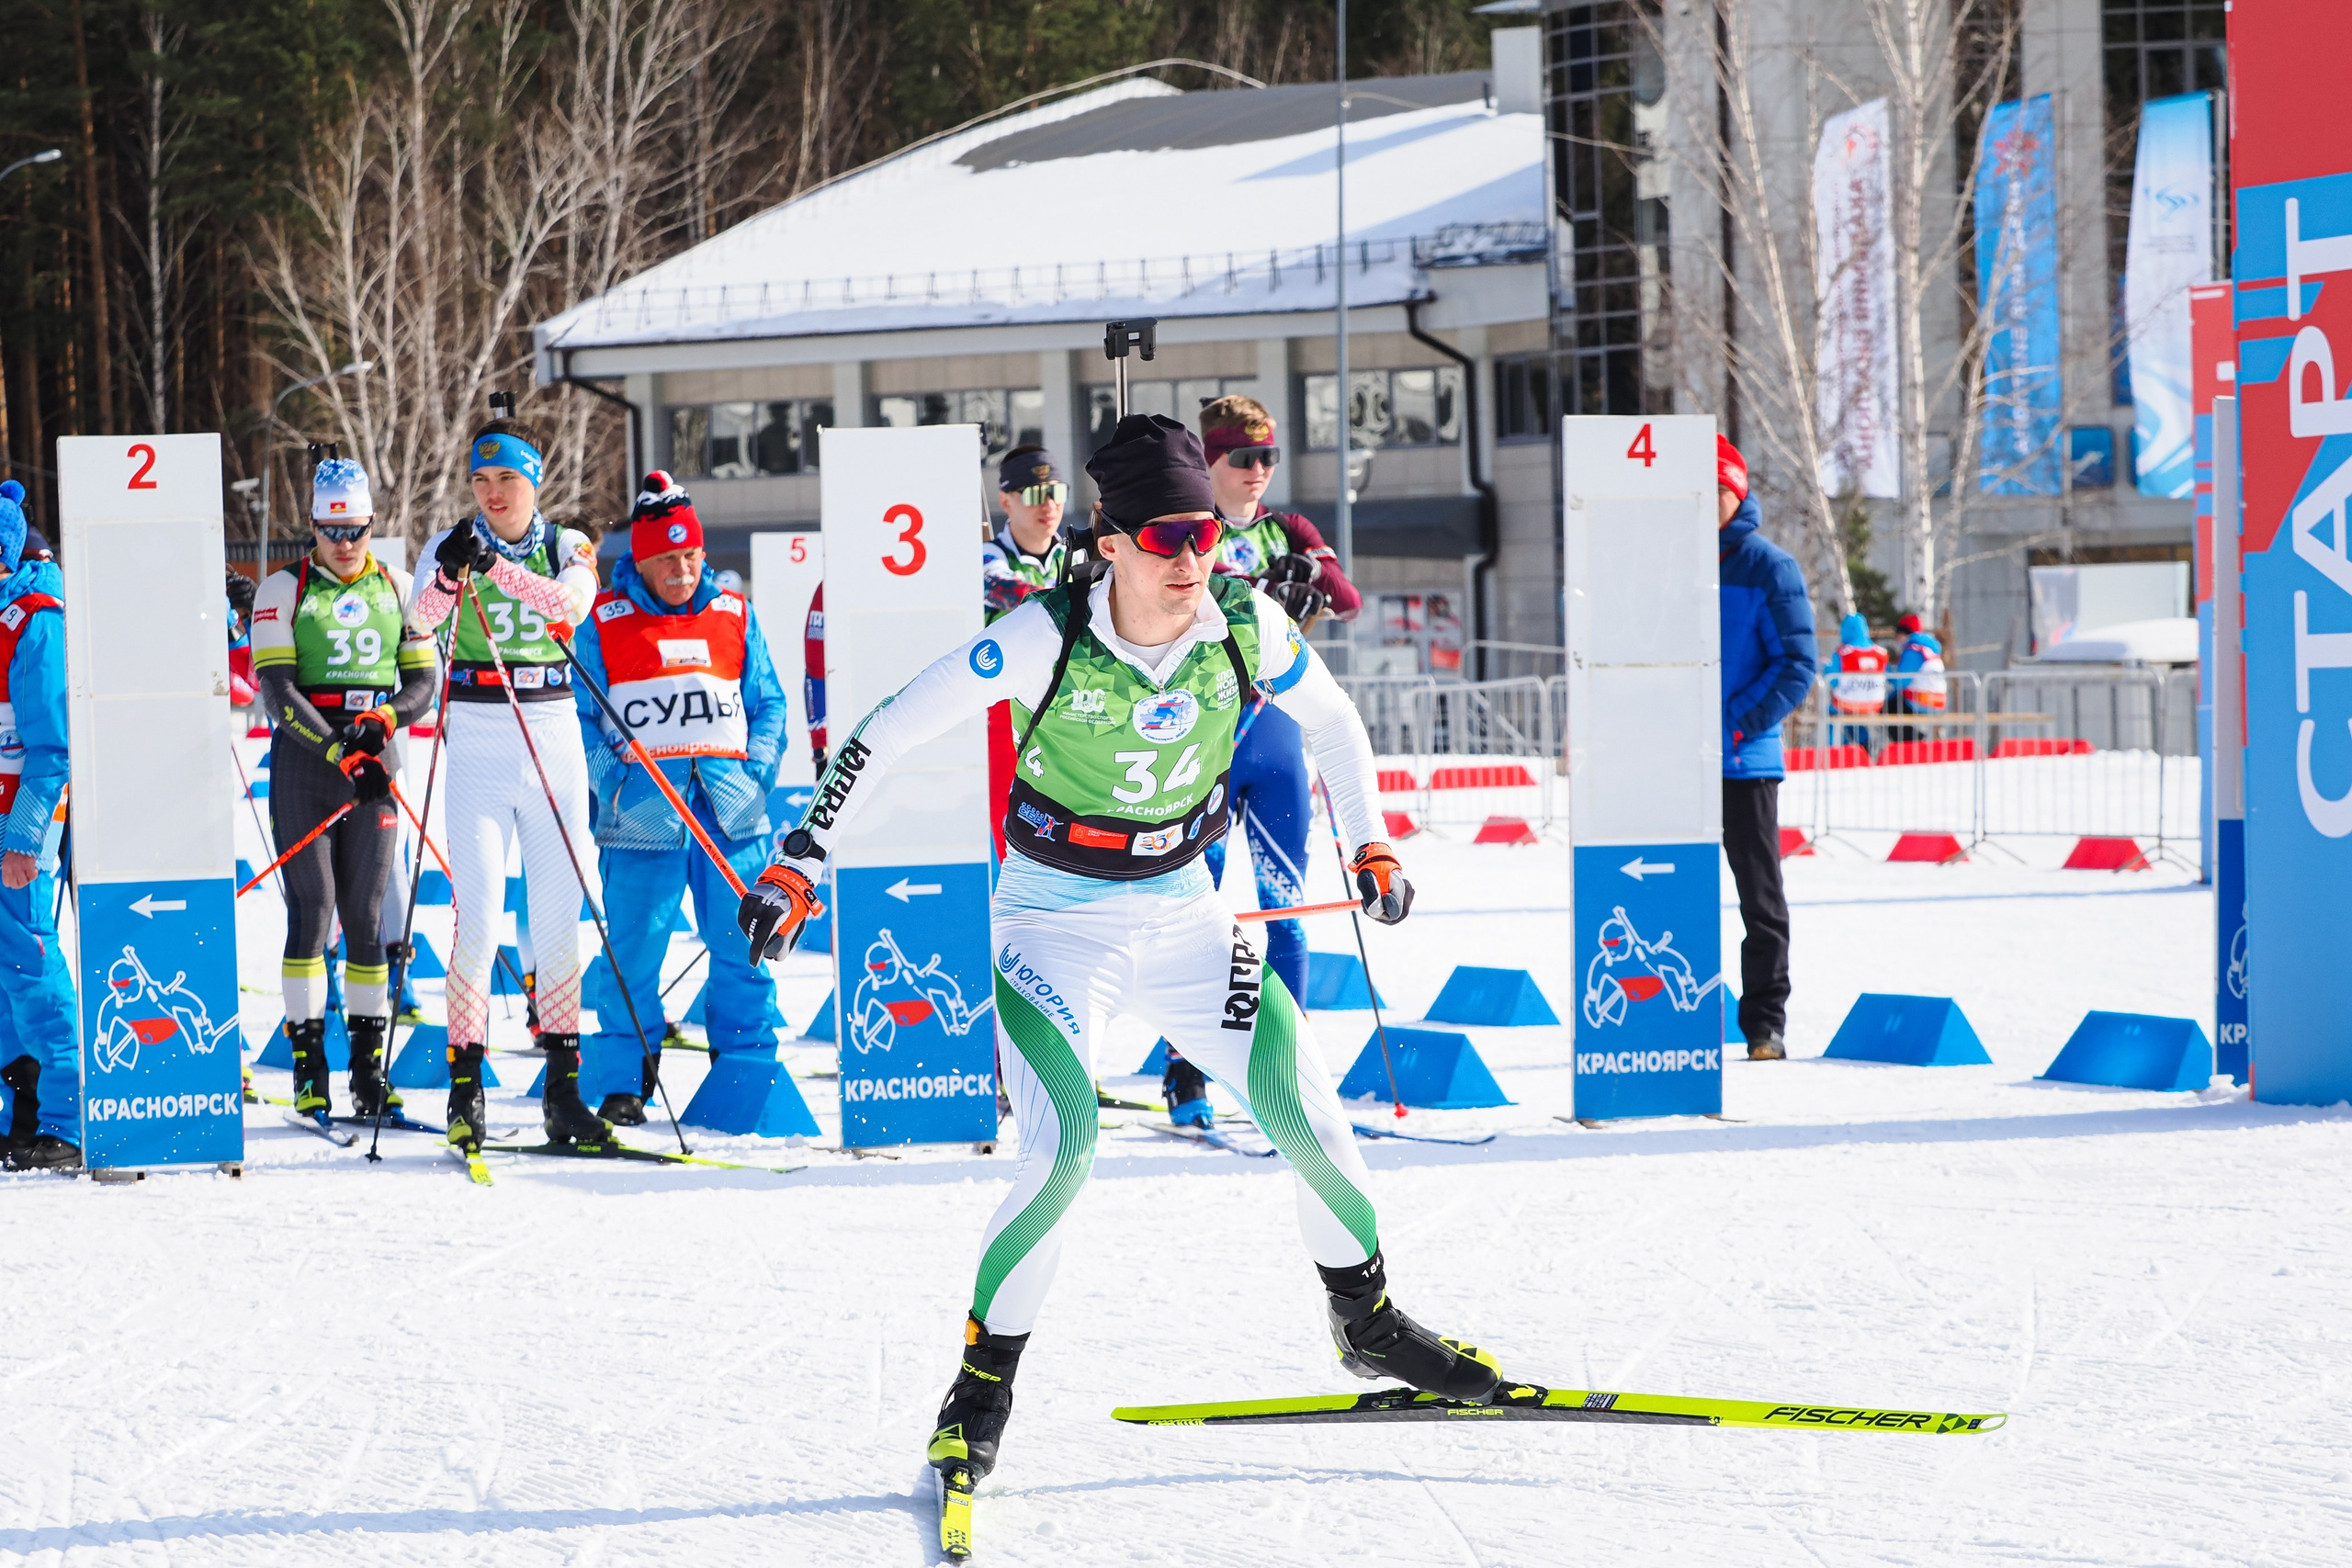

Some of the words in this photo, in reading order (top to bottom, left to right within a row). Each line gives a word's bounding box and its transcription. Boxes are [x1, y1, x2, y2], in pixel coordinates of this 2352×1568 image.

[1627, 423, 1657, 468] 4
[127, 443, 158, 490] 2
[2285, 197, 2352, 839] СТАРТ
[789, 537, 808, 564] 5
[881, 503, 927, 576] 3
[487, 603, 546, 643] 35
[604, 601, 627, 618] 35
[326, 628, 382, 666] 39
[499, 647, 543, 656] РАСНОЯРСК
[808, 736, 872, 830] ЮГРА
[1110, 740, 1203, 805] 34
[1009, 977, 1055, 1019] СТРАХОВАНИЕ
[1015, 964, 1080, 1035] ЮГОРИЯ
[1577, 1048, 1720, 1076] КРАСНОЯРСК
[87, 1092, 239, 1122] КРАСНОЯРСК
[843, 1073, 993, 1103] КРАСНОЯРСК
[1762, 1406, 1933, 1429] FISCHER
